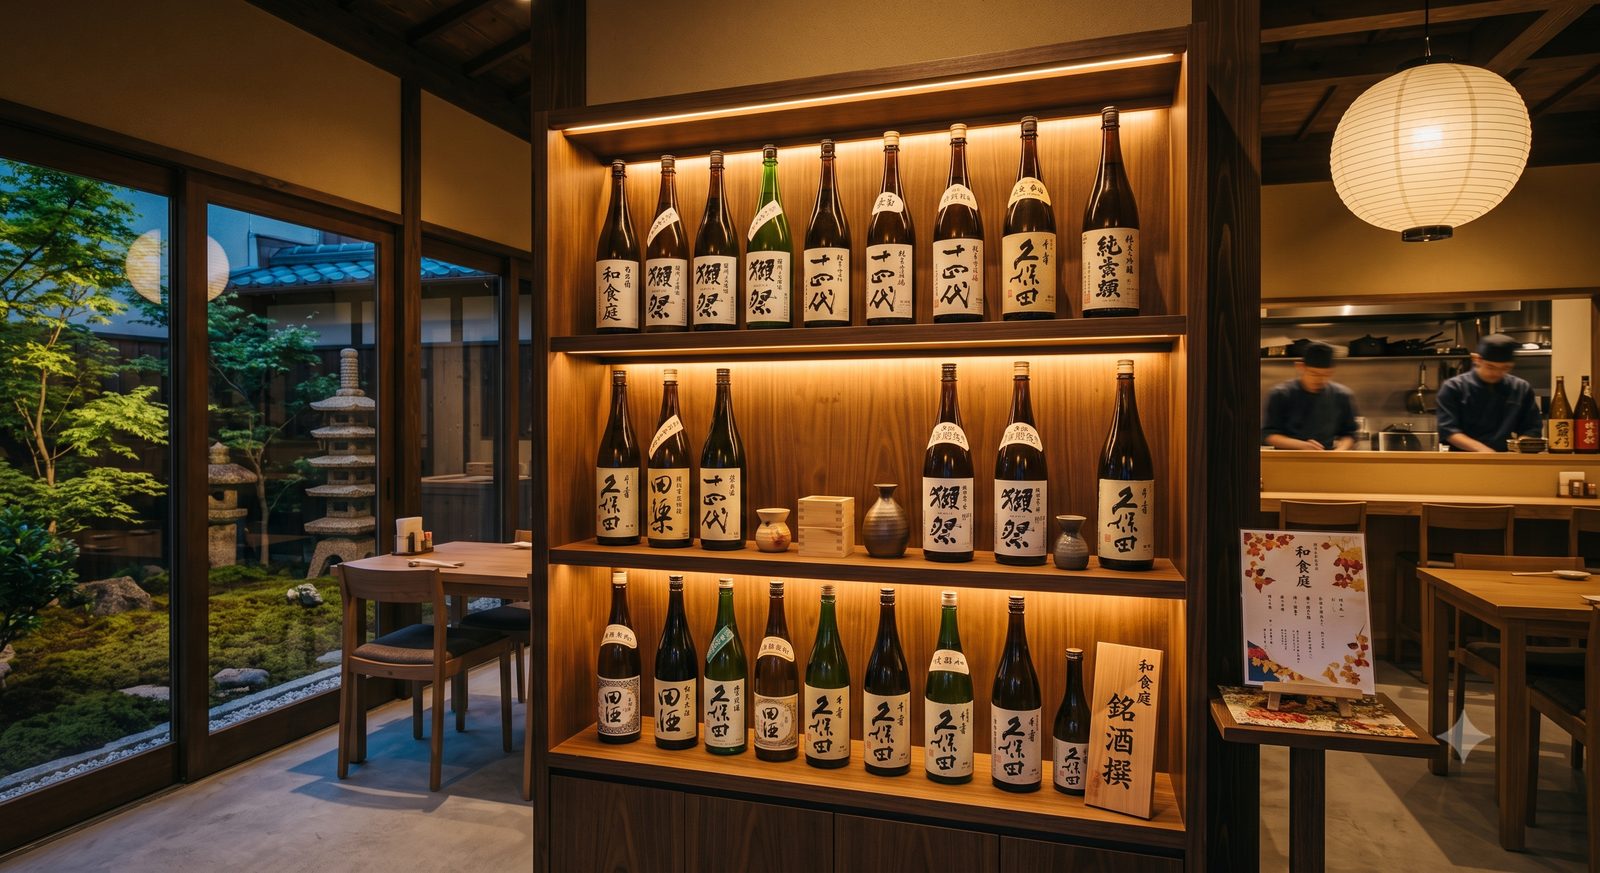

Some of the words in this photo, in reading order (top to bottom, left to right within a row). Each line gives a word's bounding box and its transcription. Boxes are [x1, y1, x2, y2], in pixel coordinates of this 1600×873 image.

[602, 265, 621, 321] 和食庭
[809, 254, 835, 315] 十四代
[869, 250, 896, 312] 十四代
[940, 244, 970, 308] 十四代
[1010, 238, 1039, 306] 久保田
[598, 473, 621, 531] 久保田
[702, 475, 728, 534] 十四代
[929, 485, 960, 545] 獺祭
[1001, 487, 1034, 549] 獺祭
[1108, 486, 1138, 553] 久保田
[1295, 545, 1313, 589] 和食庭
[658, 687, 681, 733] 田酒
[708, 684, 730, 738] 久保田
[1137, 659, 1155, 707] 和食庭
[809, 695, 833, 753] 久保田
[868, 701, 895, 761] 久保田
[930, 709, 958, 770] 久保田
[997, 716, 1026, 776] 久保田
[1102, 692, 1136, 790] 銘酒撰
[1061, 746, 1081, 785] 久保田
